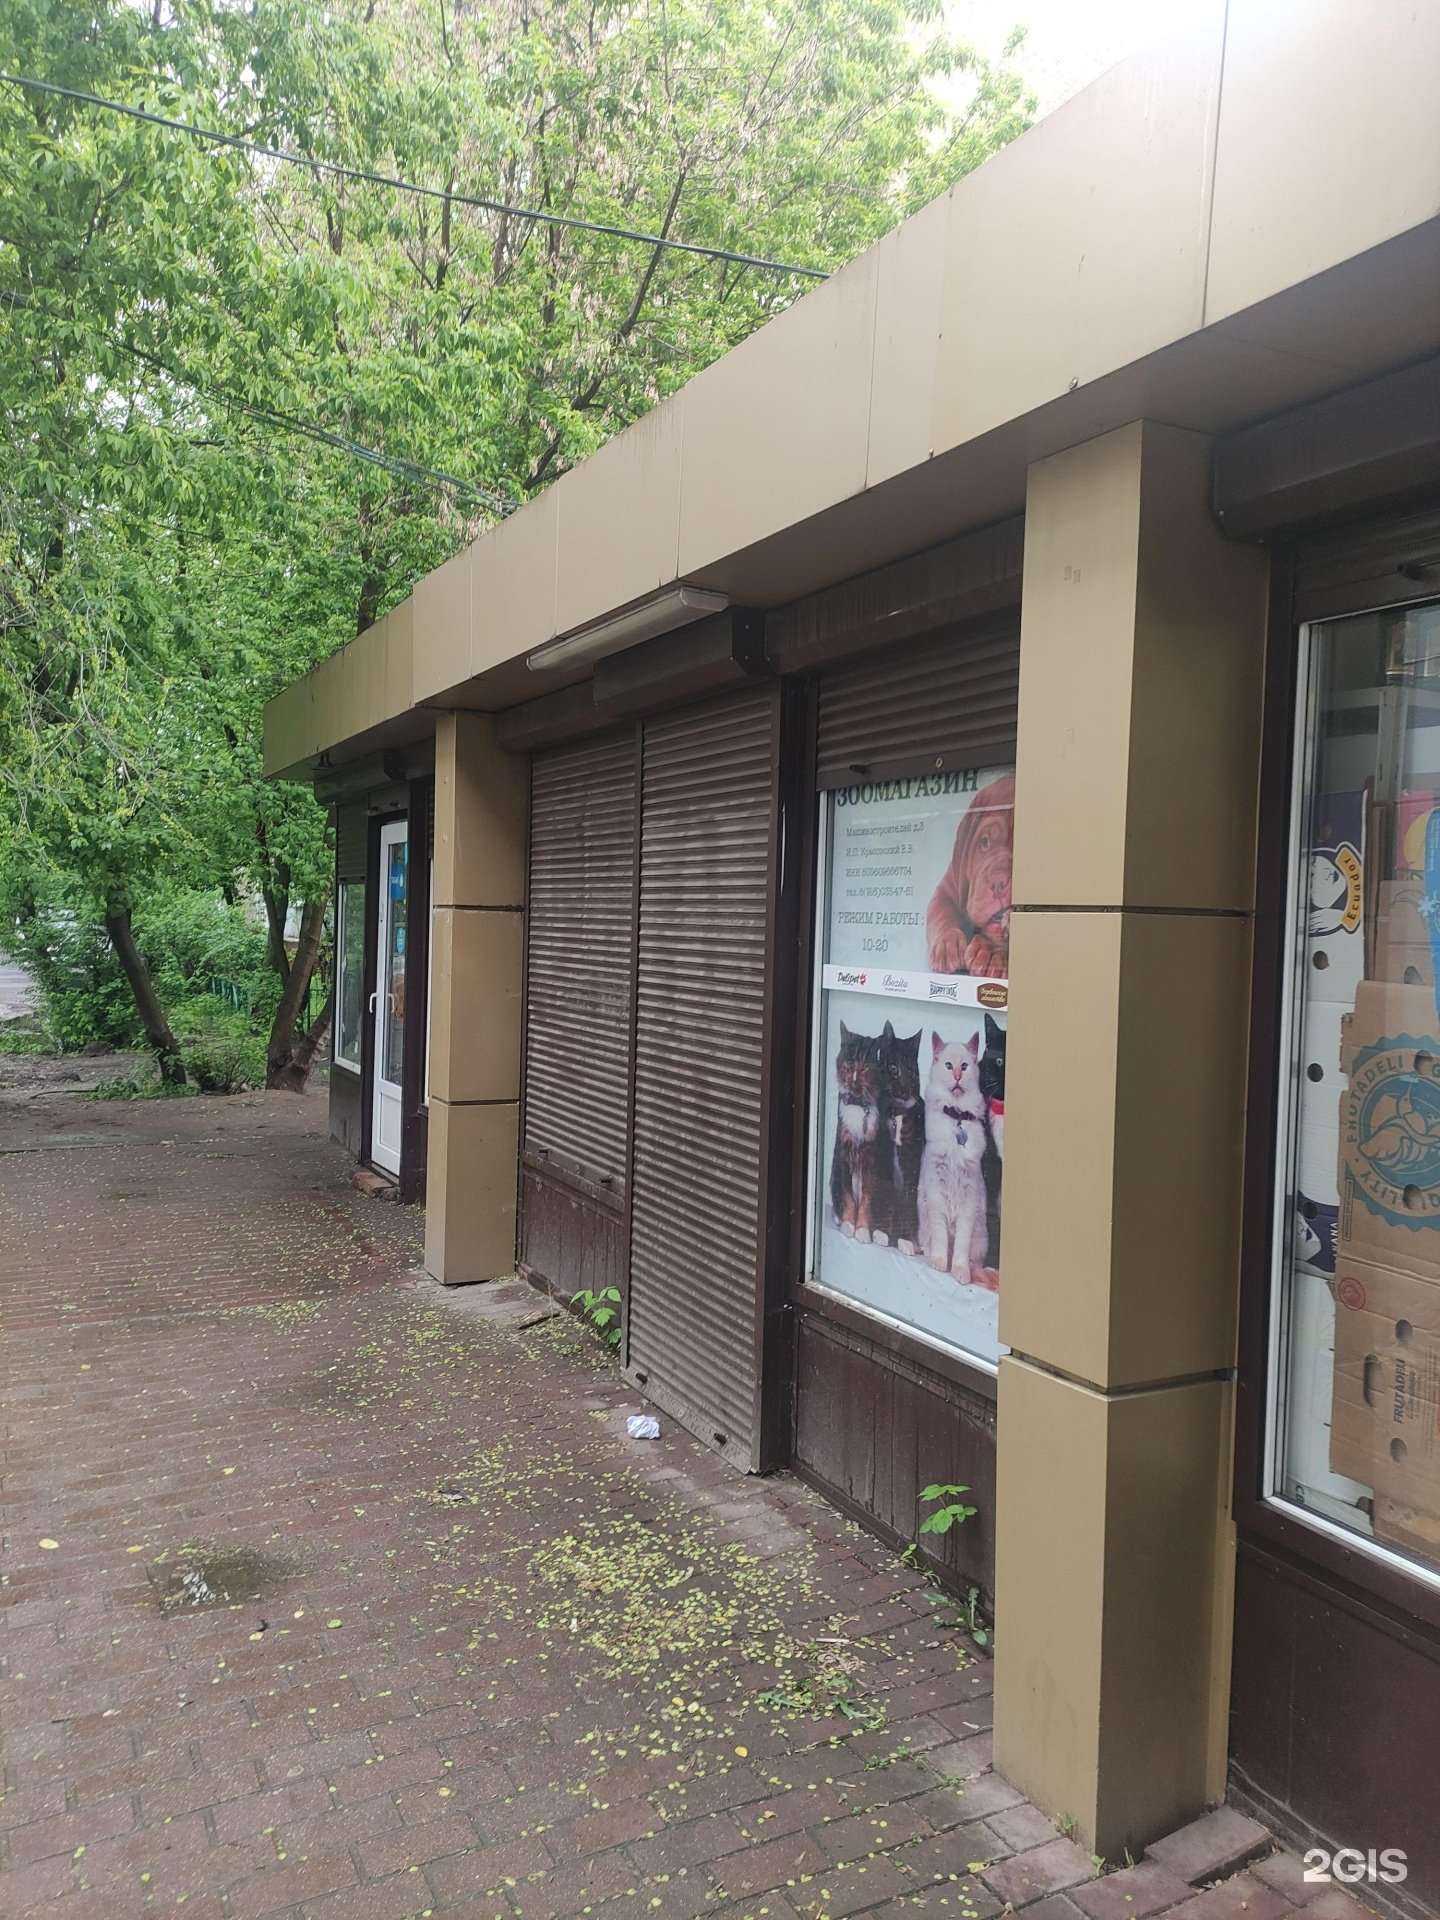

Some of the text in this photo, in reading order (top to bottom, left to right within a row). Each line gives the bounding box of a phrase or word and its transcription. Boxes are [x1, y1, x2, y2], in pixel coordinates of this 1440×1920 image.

[837, 767, 979, 807] ЗООМАГАЗИН
[1344, 857, 1361, 920] Ecuador
[838, 911, 874, 924] РЕЖИМ
[862, 938, 889, 952] 10-20
